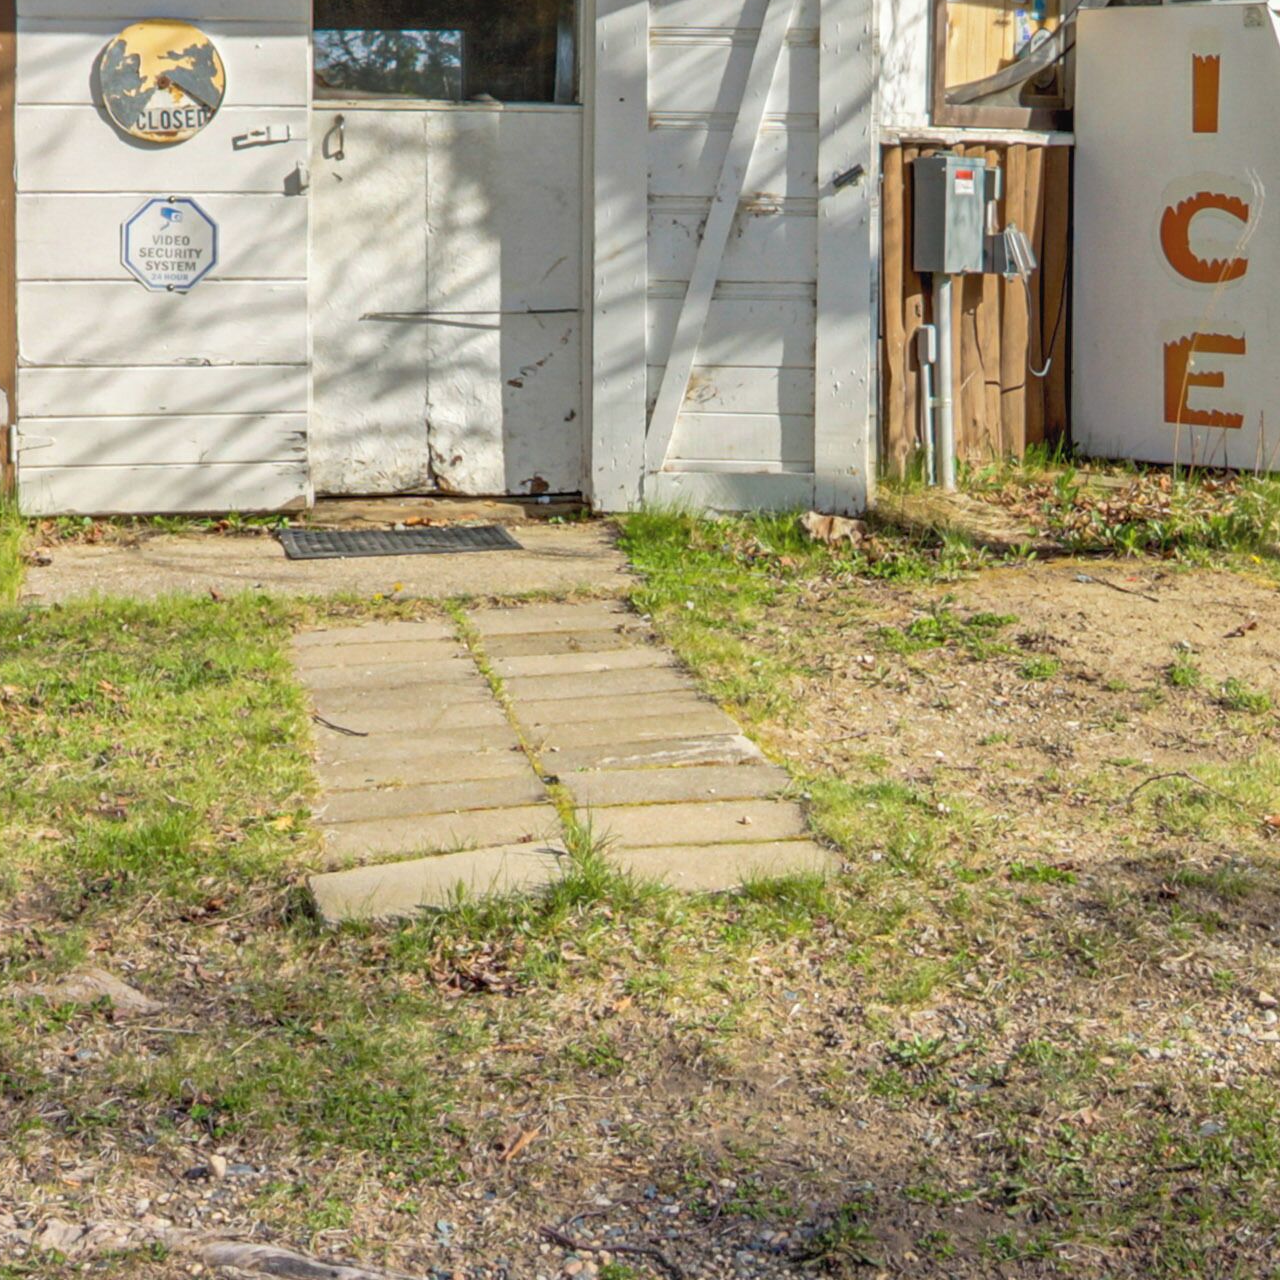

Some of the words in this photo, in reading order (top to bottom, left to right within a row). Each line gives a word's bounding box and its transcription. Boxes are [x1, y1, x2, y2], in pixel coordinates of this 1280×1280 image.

[136, 109, 208, 130] CLOSED
[152, 235, 190, 246] VIDEO
[139, 247, 203, 259] SECURITY
[145, 261, 196, 272] SYSTEM
[164, 273, 189, 281] HOUR
